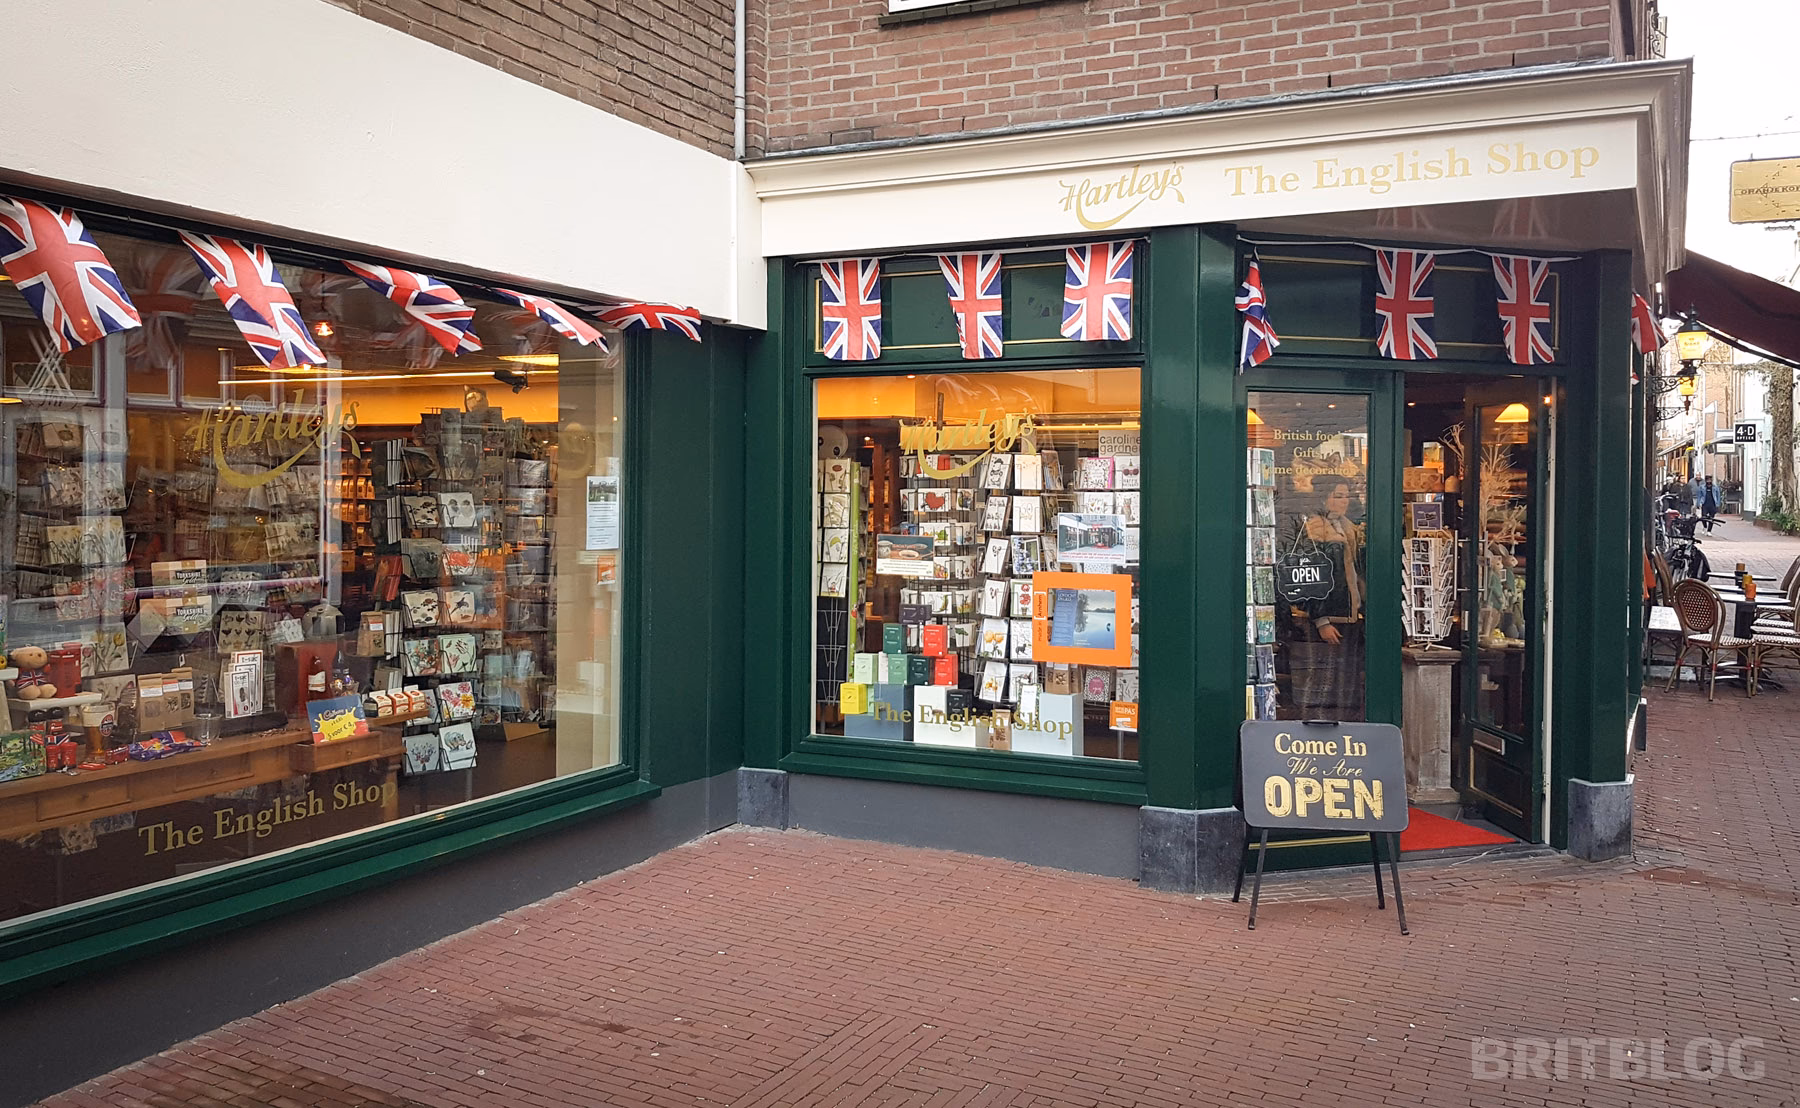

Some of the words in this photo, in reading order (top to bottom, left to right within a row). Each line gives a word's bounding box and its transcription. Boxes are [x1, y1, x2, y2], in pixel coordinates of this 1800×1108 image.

[1058, 160, 1186, 230] Hartley's
[1225, 165, 1300, 197] The
[1312, 147, 1471, 195] English
[1487, 141, 1600, 182] Shop
[185, 388, 362, 489] Hartley's
[899, 408, 1037, 480] Hartley's
[1100, 434, 1140, 444] caroline
[1273, 428, 1313, 441] British
[1100, 444, 1140, 455] gardne
[1293, 446, 1321, 458] Gifts
[1295, 463, 1357, 476] decoration
[176, 571, 201, 579] YORKSHIRE
[1291, 566, 1320, 583] OPEN
[176, 607, 203, 616] YORKSHIRE
[871, 701, 913, 723] The
[918, 703, 1005, 733] English
[1013, 710, 1073, 740] Shop
[1274, 732, 1338, 756] Come
[1343, 735, 1368, 757] In
[1286, 756, 1318, 776] We
[1322, 758, 1363, 777] Are
[1264, 775, 1385, 821] OPEN
[138, 820, 204, 856] The
[213, 790, 326, 840] English
[333, 780, 397, 811] Shop
